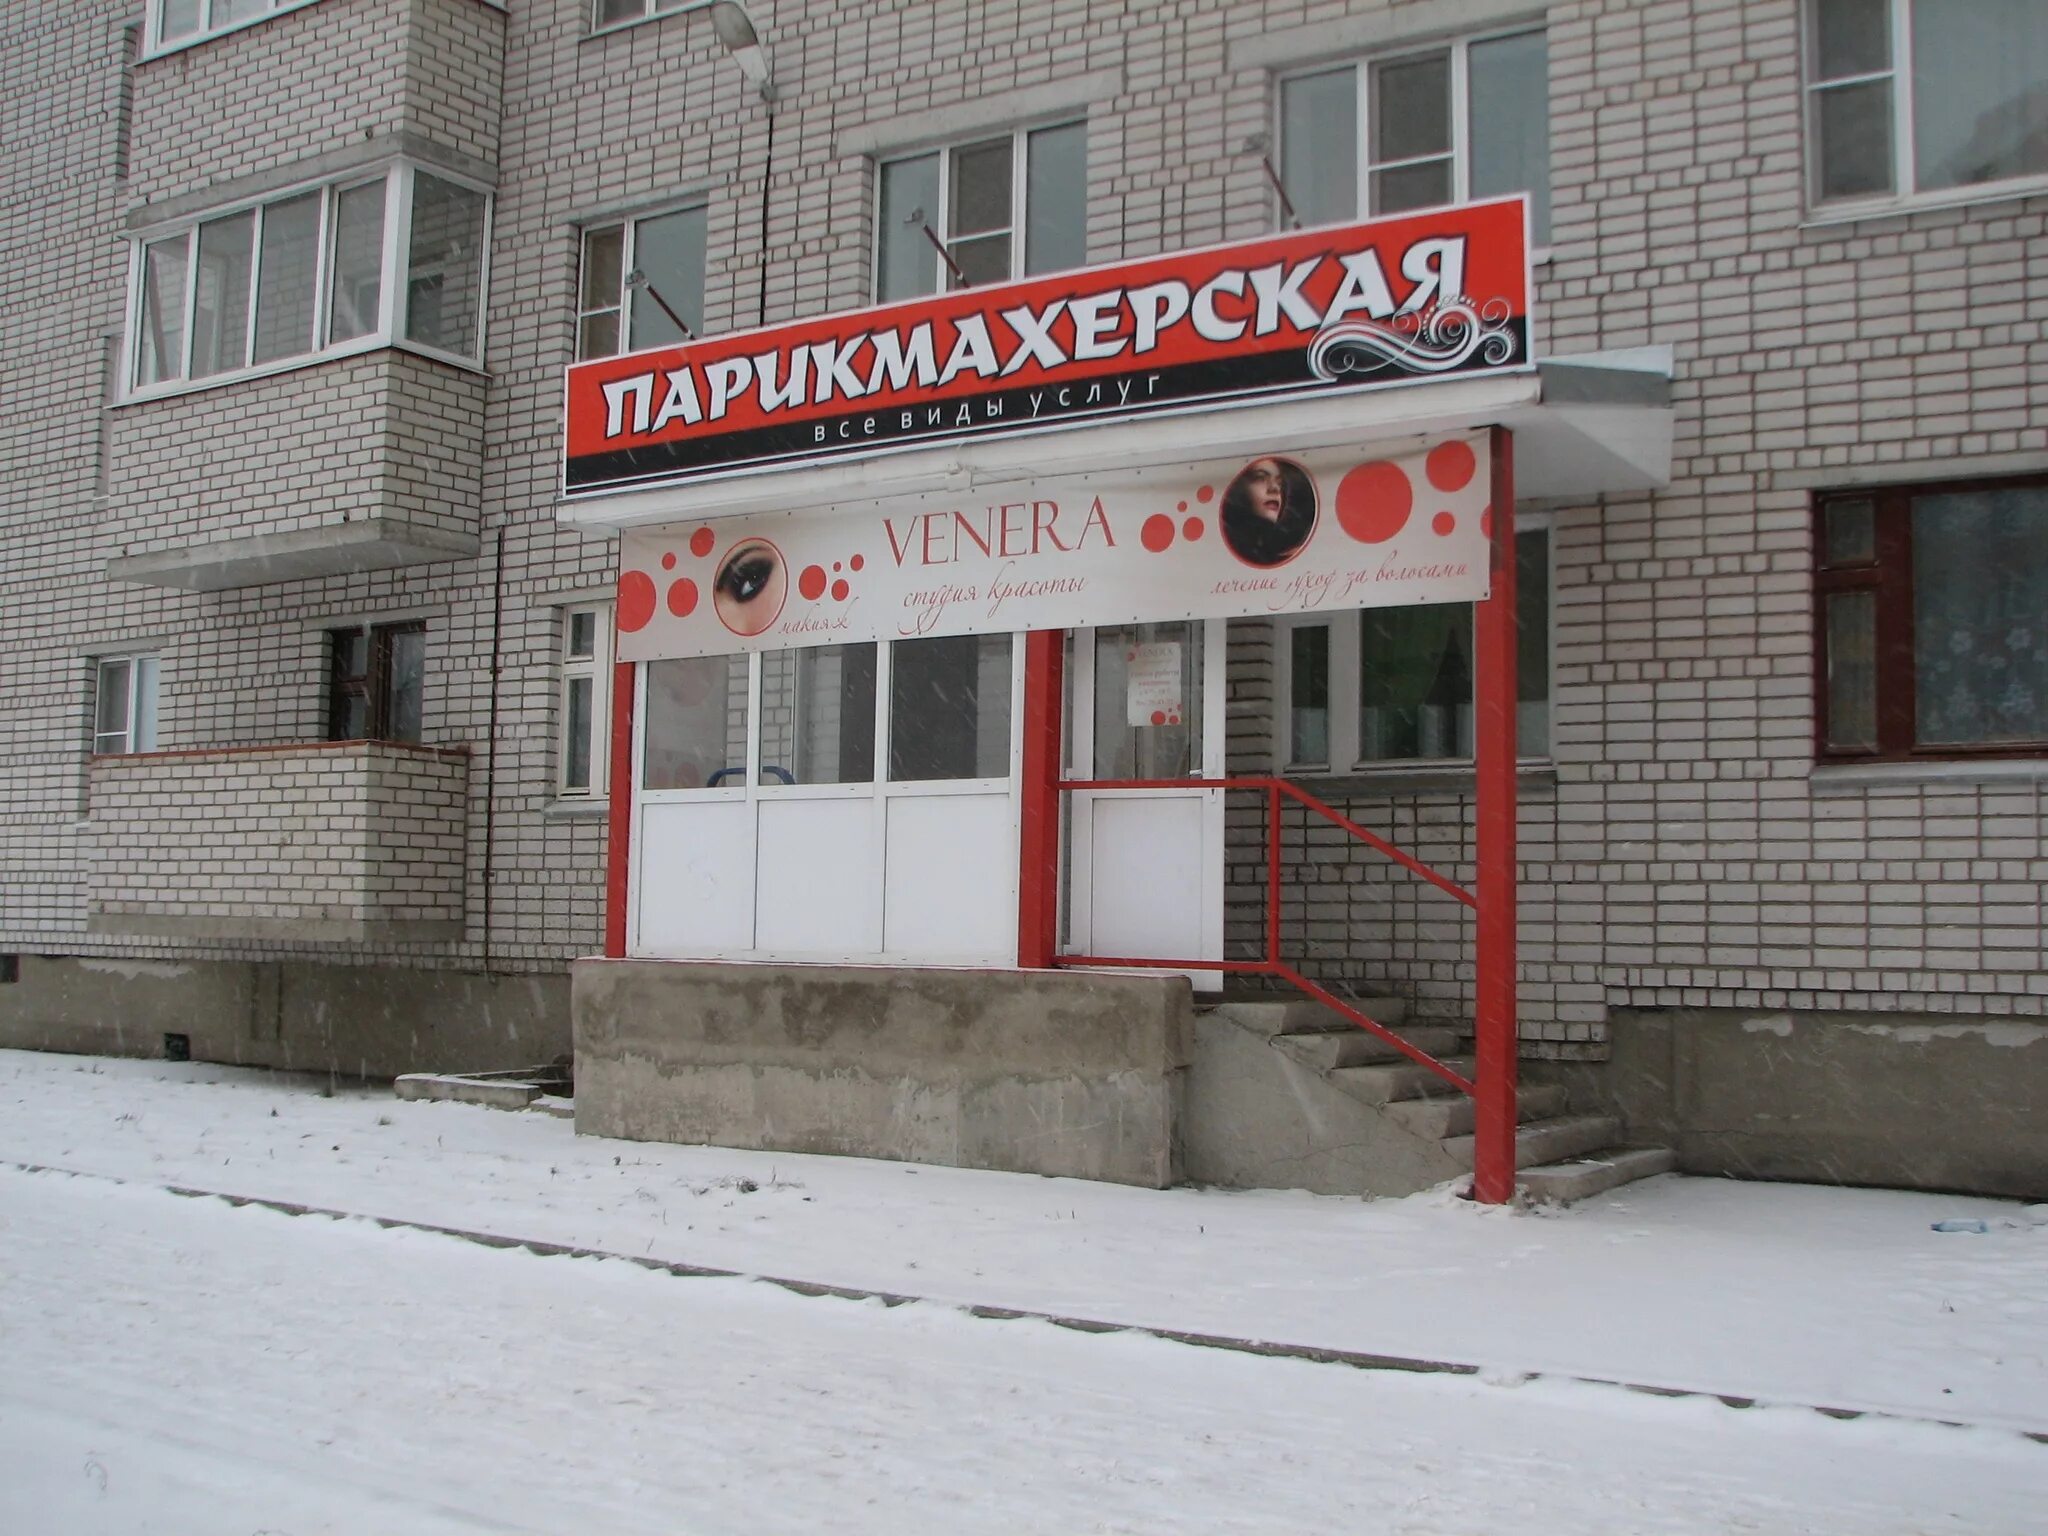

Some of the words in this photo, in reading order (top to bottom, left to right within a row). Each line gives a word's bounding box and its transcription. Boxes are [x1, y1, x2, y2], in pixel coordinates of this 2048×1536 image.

[602, 235, 1467, 438] ПАРИКМАХЕРСКАЯ
[814, 416, 876, 442] все
[901, 398, 1002, 428] виды
[1030, 375, 1160, 417] услуг
[882, 495, 1117, 568] VENERA
[897, 585, 979, 635] студия
[987, 561, 1086, 619] красоты
[1210, 577, 1278, 594] лечение
[1335, 570, 1367, 600] за
[1376, 549, 1467, 582] волосами
[778, 596, 859, 634] макияж
